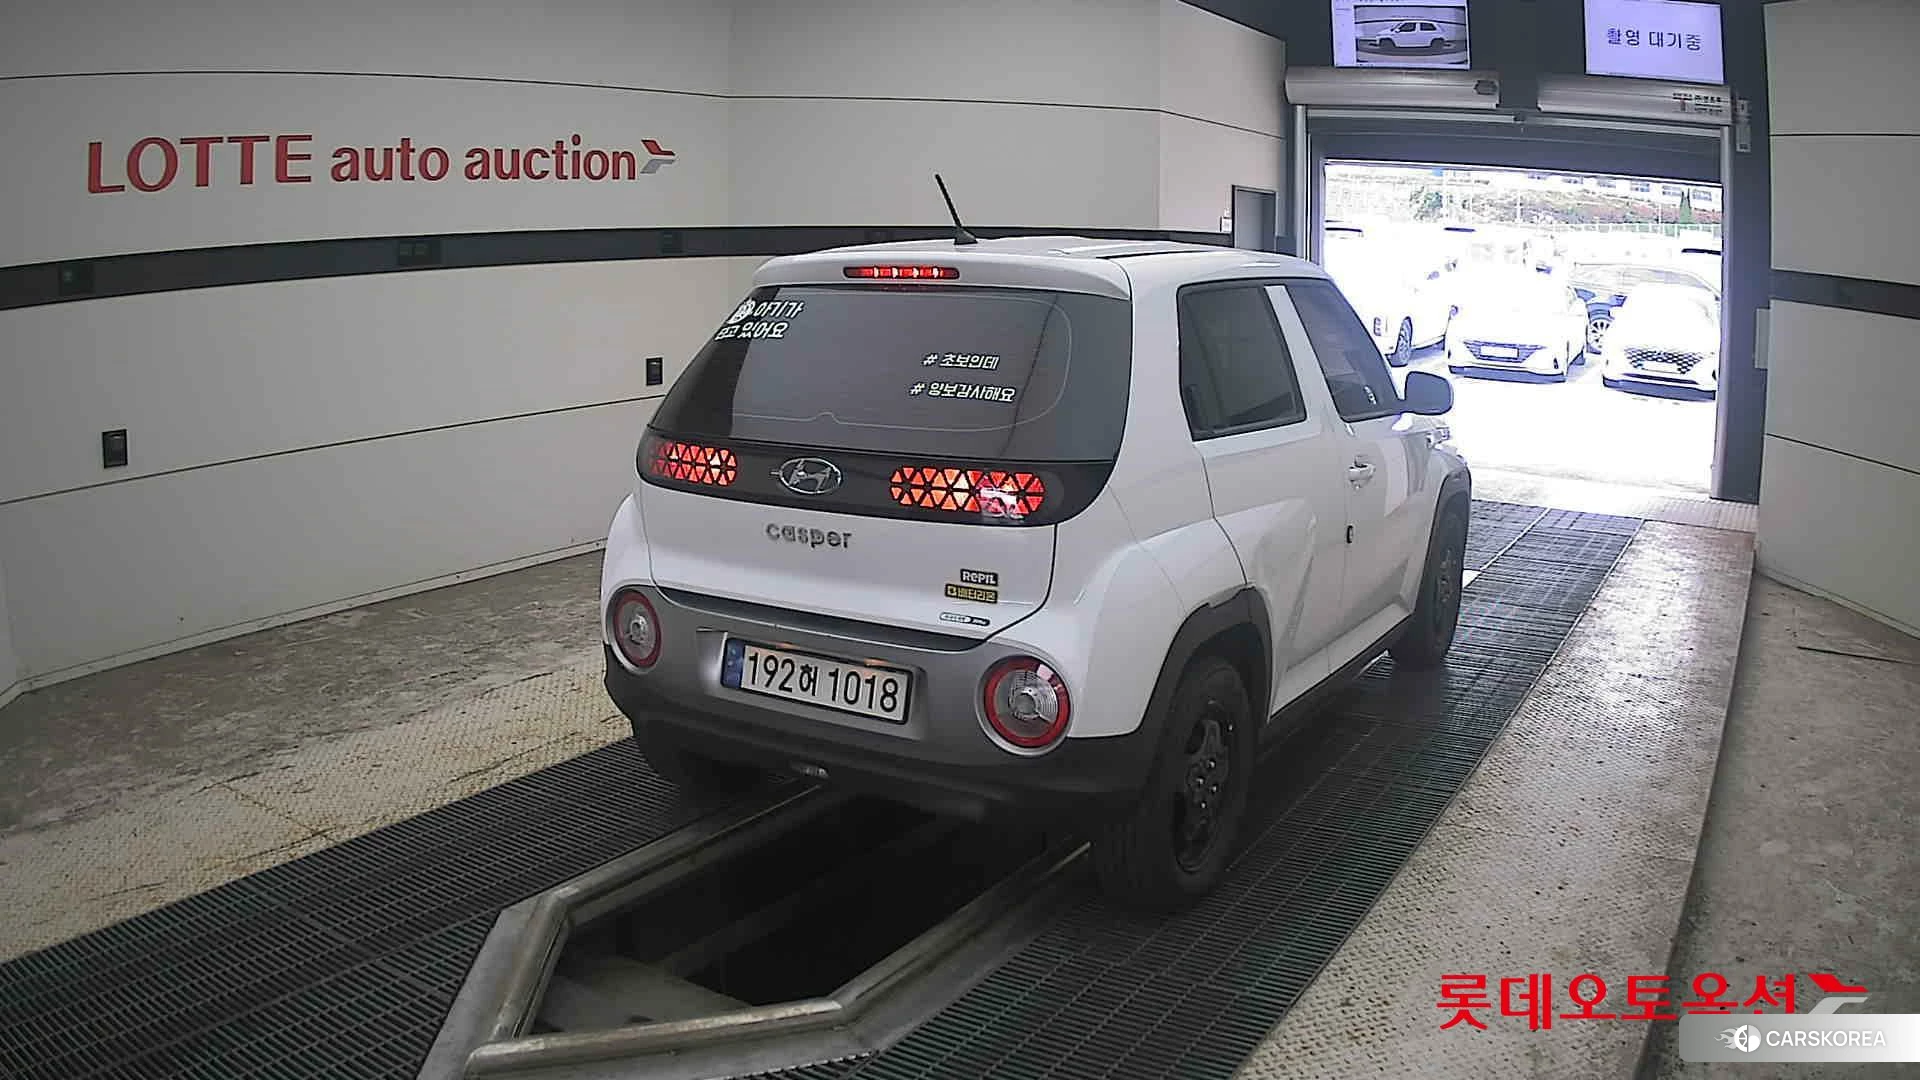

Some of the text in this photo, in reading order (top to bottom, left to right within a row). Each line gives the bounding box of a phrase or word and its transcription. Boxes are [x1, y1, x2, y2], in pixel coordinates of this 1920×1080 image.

[1606, 27, 1640, 47] 촬영
[87, 134, 637, 194] LOTTE auto auction
[752, 300, 805, 319] 아기가
[736, 321, 789, 339] 있어요
[939, 352, 1000, 370] 초보인데
[927, 382, 1017, 403] 양보감사해요
[765, 522, 853, 550] casper
[748, 651, 900, 713] 192허 1018
